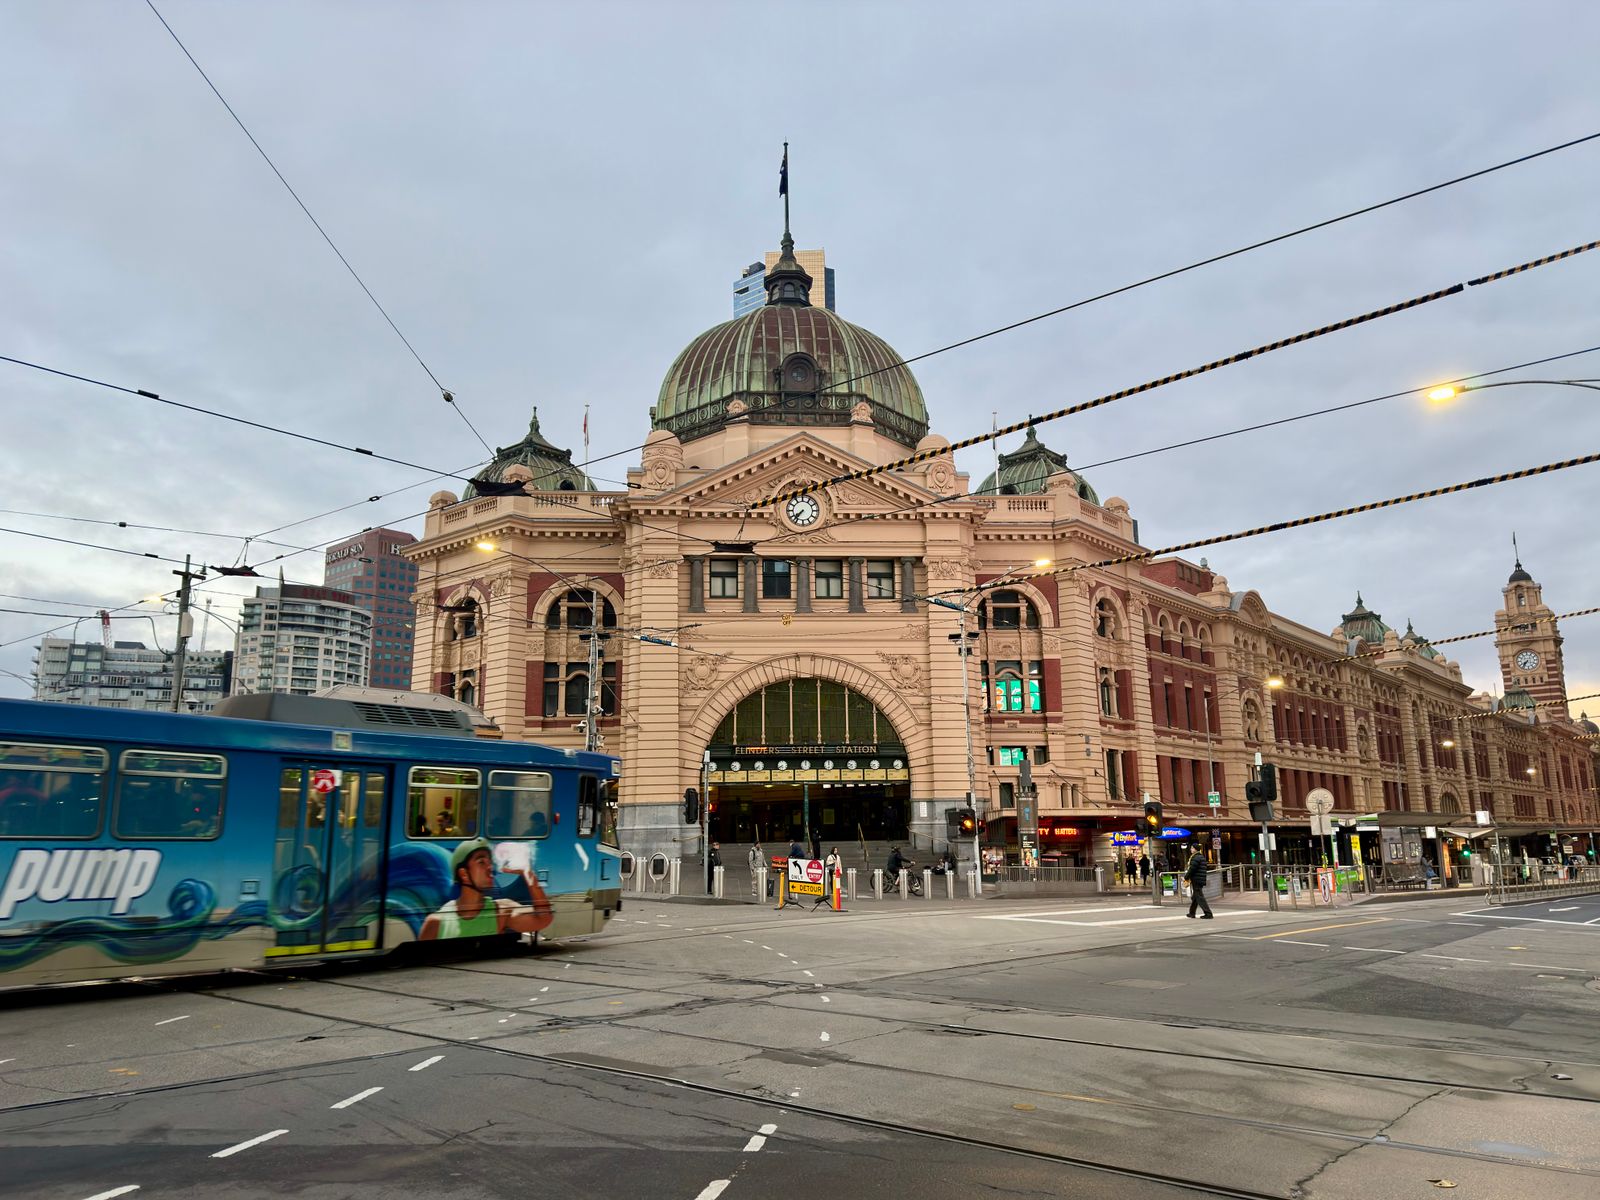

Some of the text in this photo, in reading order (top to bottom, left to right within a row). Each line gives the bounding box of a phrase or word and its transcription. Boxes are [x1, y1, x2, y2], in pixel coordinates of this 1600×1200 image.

[350, 542, 364, 554] SUN
[735, 745, 877, 755] FLINDERS STREET STATION
[799, 885, 821, 893] DETOUR
